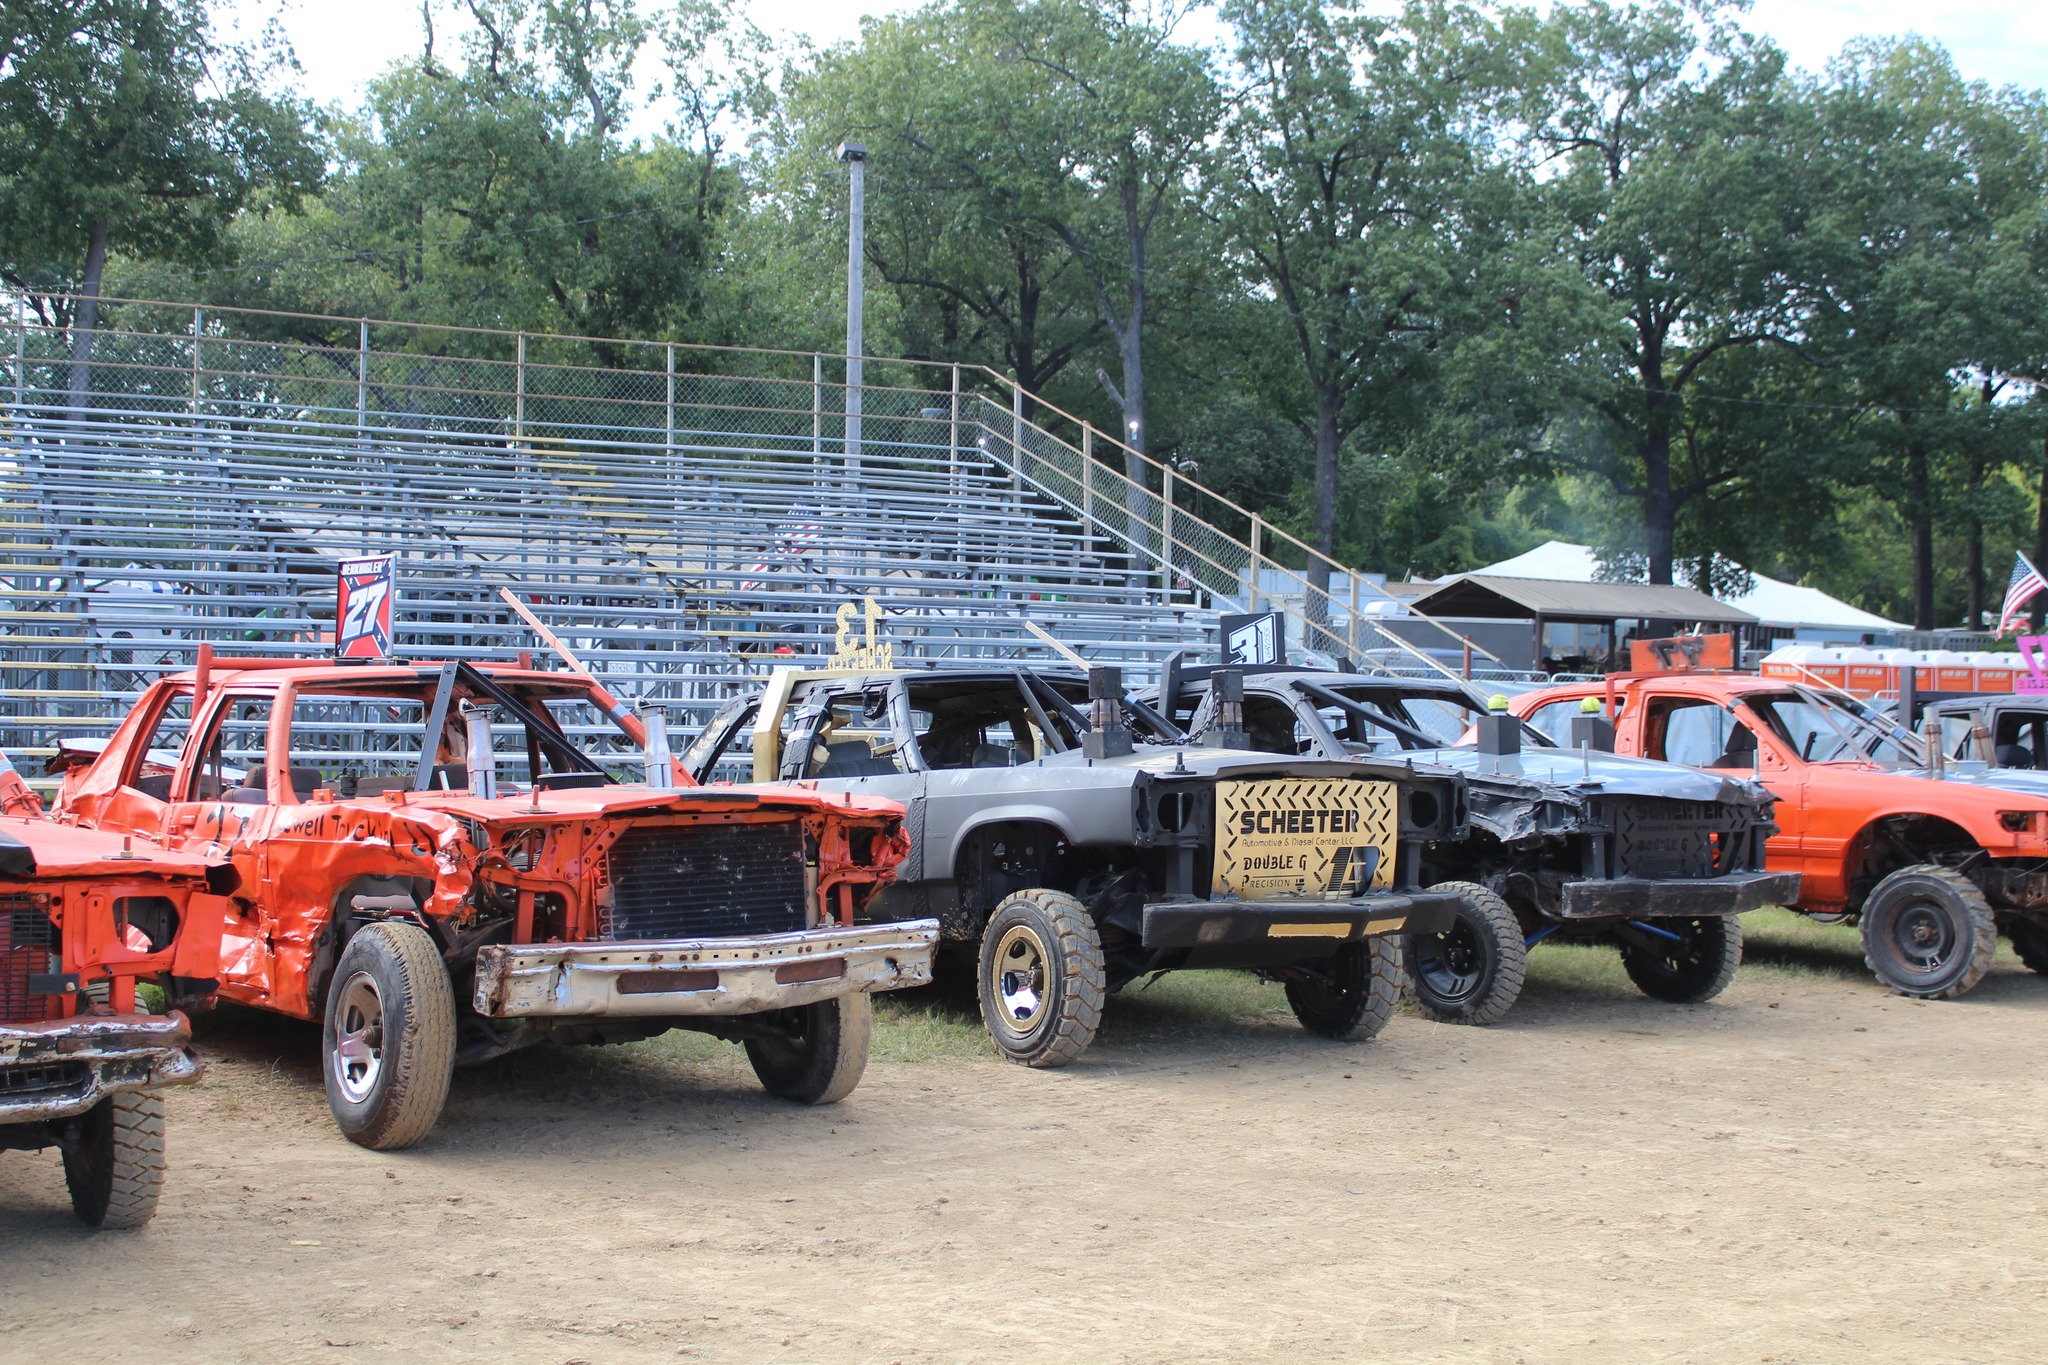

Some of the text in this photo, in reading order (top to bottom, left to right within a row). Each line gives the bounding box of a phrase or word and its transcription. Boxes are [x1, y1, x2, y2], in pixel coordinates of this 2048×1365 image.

[341, 580, 389, 640] 27
[1230, 614, 1276, 665] 31
[1240, 809, 1360, 834] SCHEETER
[1242, 838, 1283, 848] Automotive
[1284, 838, 1290, 846] &
[1291, 837, 1314, 846] Diesel
[1315, 836, 1339, 846] Center
[1243, 854, 1308, 871] DOUBLE G
